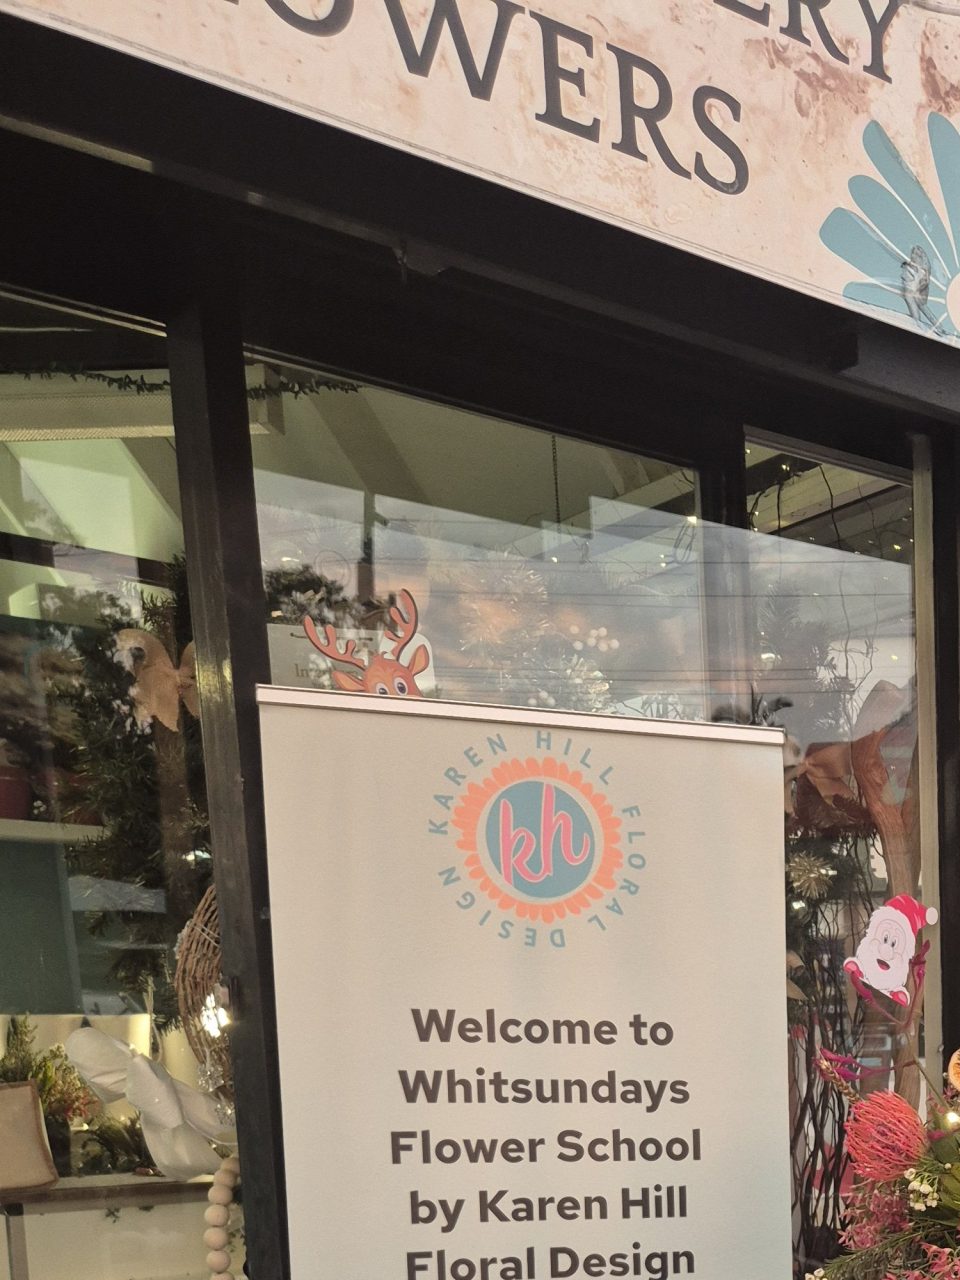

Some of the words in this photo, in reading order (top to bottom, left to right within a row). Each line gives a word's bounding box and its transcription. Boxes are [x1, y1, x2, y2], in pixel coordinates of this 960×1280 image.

[428, 733, 507, 835] KAREN
[536, 730, 613, 785] HILL
[588, 805, 646, 931] FLORAL
[438, 866, 566, 948] DESIGN
[411, 1008, 618, 1045] Welcome
[629, 1014, 674, 1046] to
[399, 1067, 691, 1113] Whitsundays
[390, 1129, 546, 1165] Flower
[556, 1128, 702, 1163] School
[409, 1189, 466, 1234] by
[478, 1189, 608, 1223] Karen
[621, 1183, 688, 1220] Hill
